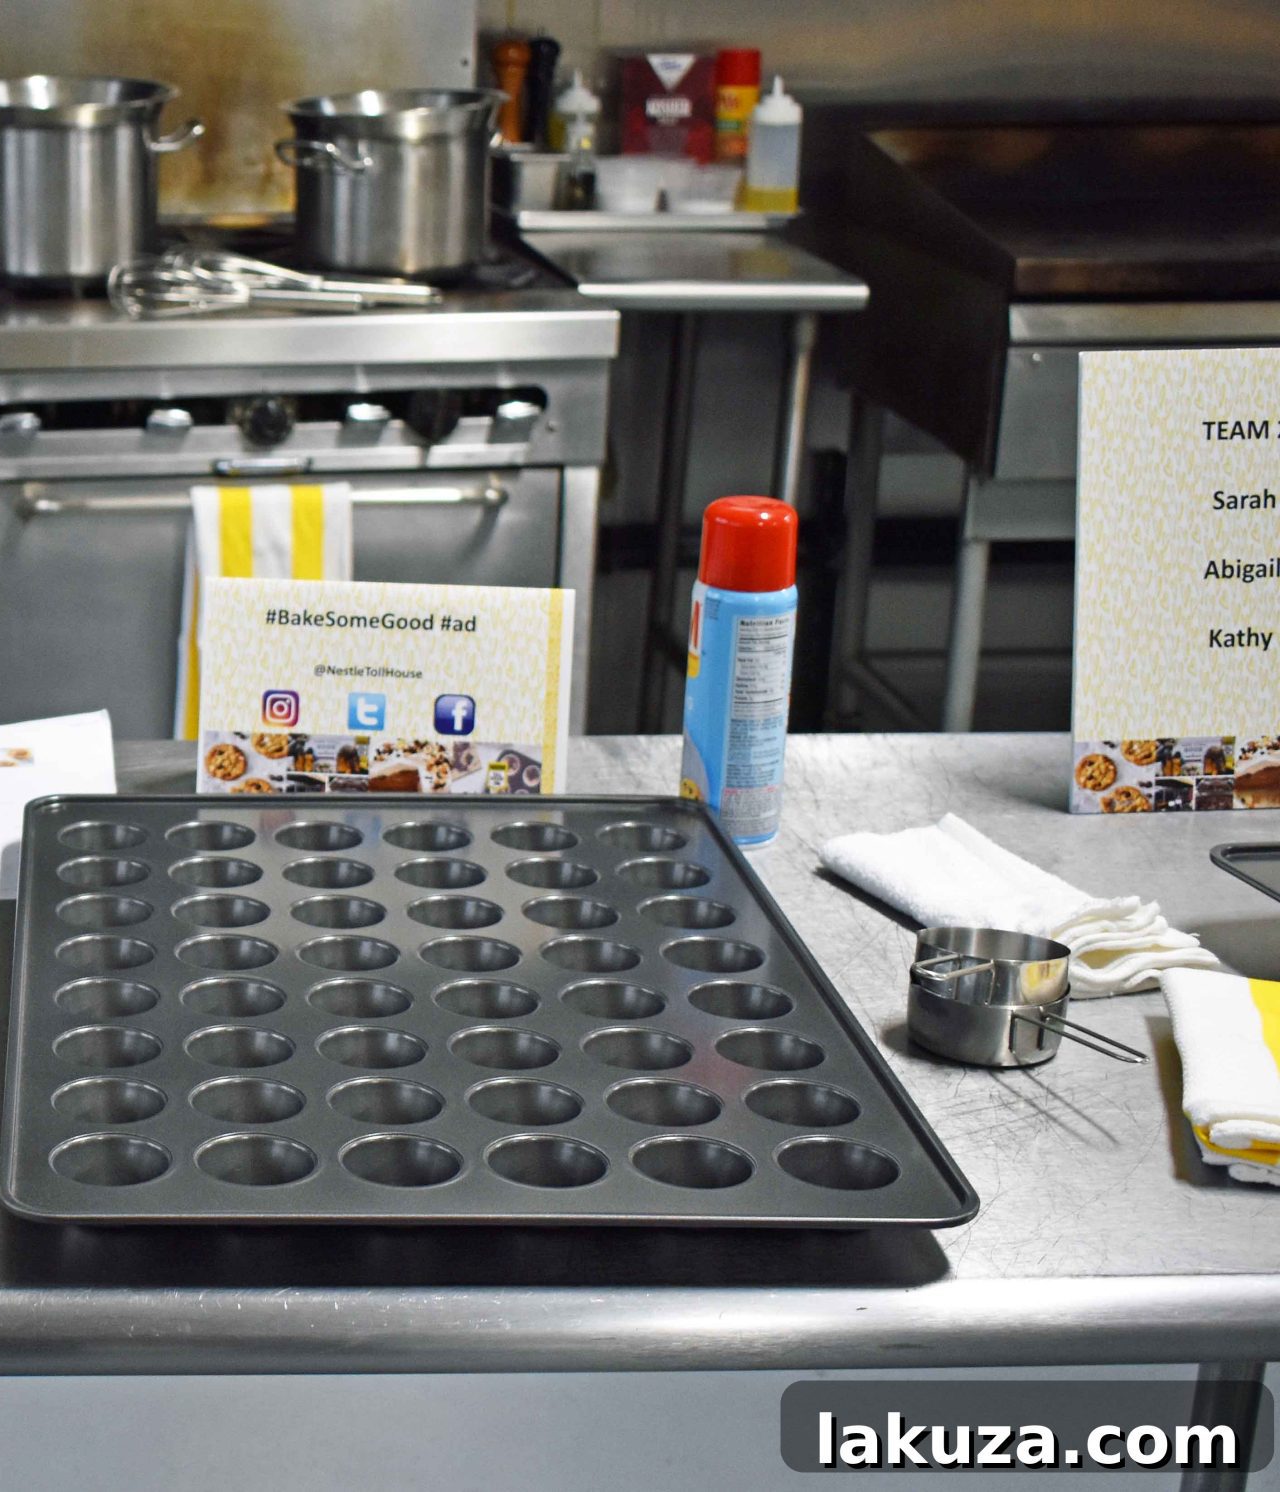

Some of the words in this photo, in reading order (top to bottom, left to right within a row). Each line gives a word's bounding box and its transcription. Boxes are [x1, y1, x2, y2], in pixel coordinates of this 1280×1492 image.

[1202, 420, 1269, 440] TEAM
[1213, 489, 1276, 510] Sarah
[266, 609, 434, 631] #BakeSomeGood
[440, 615, 477, 632] #ad
[1209, 627, 1273, 651] Kathy
[313, 664, 423, 679] @NestleTollHouse
